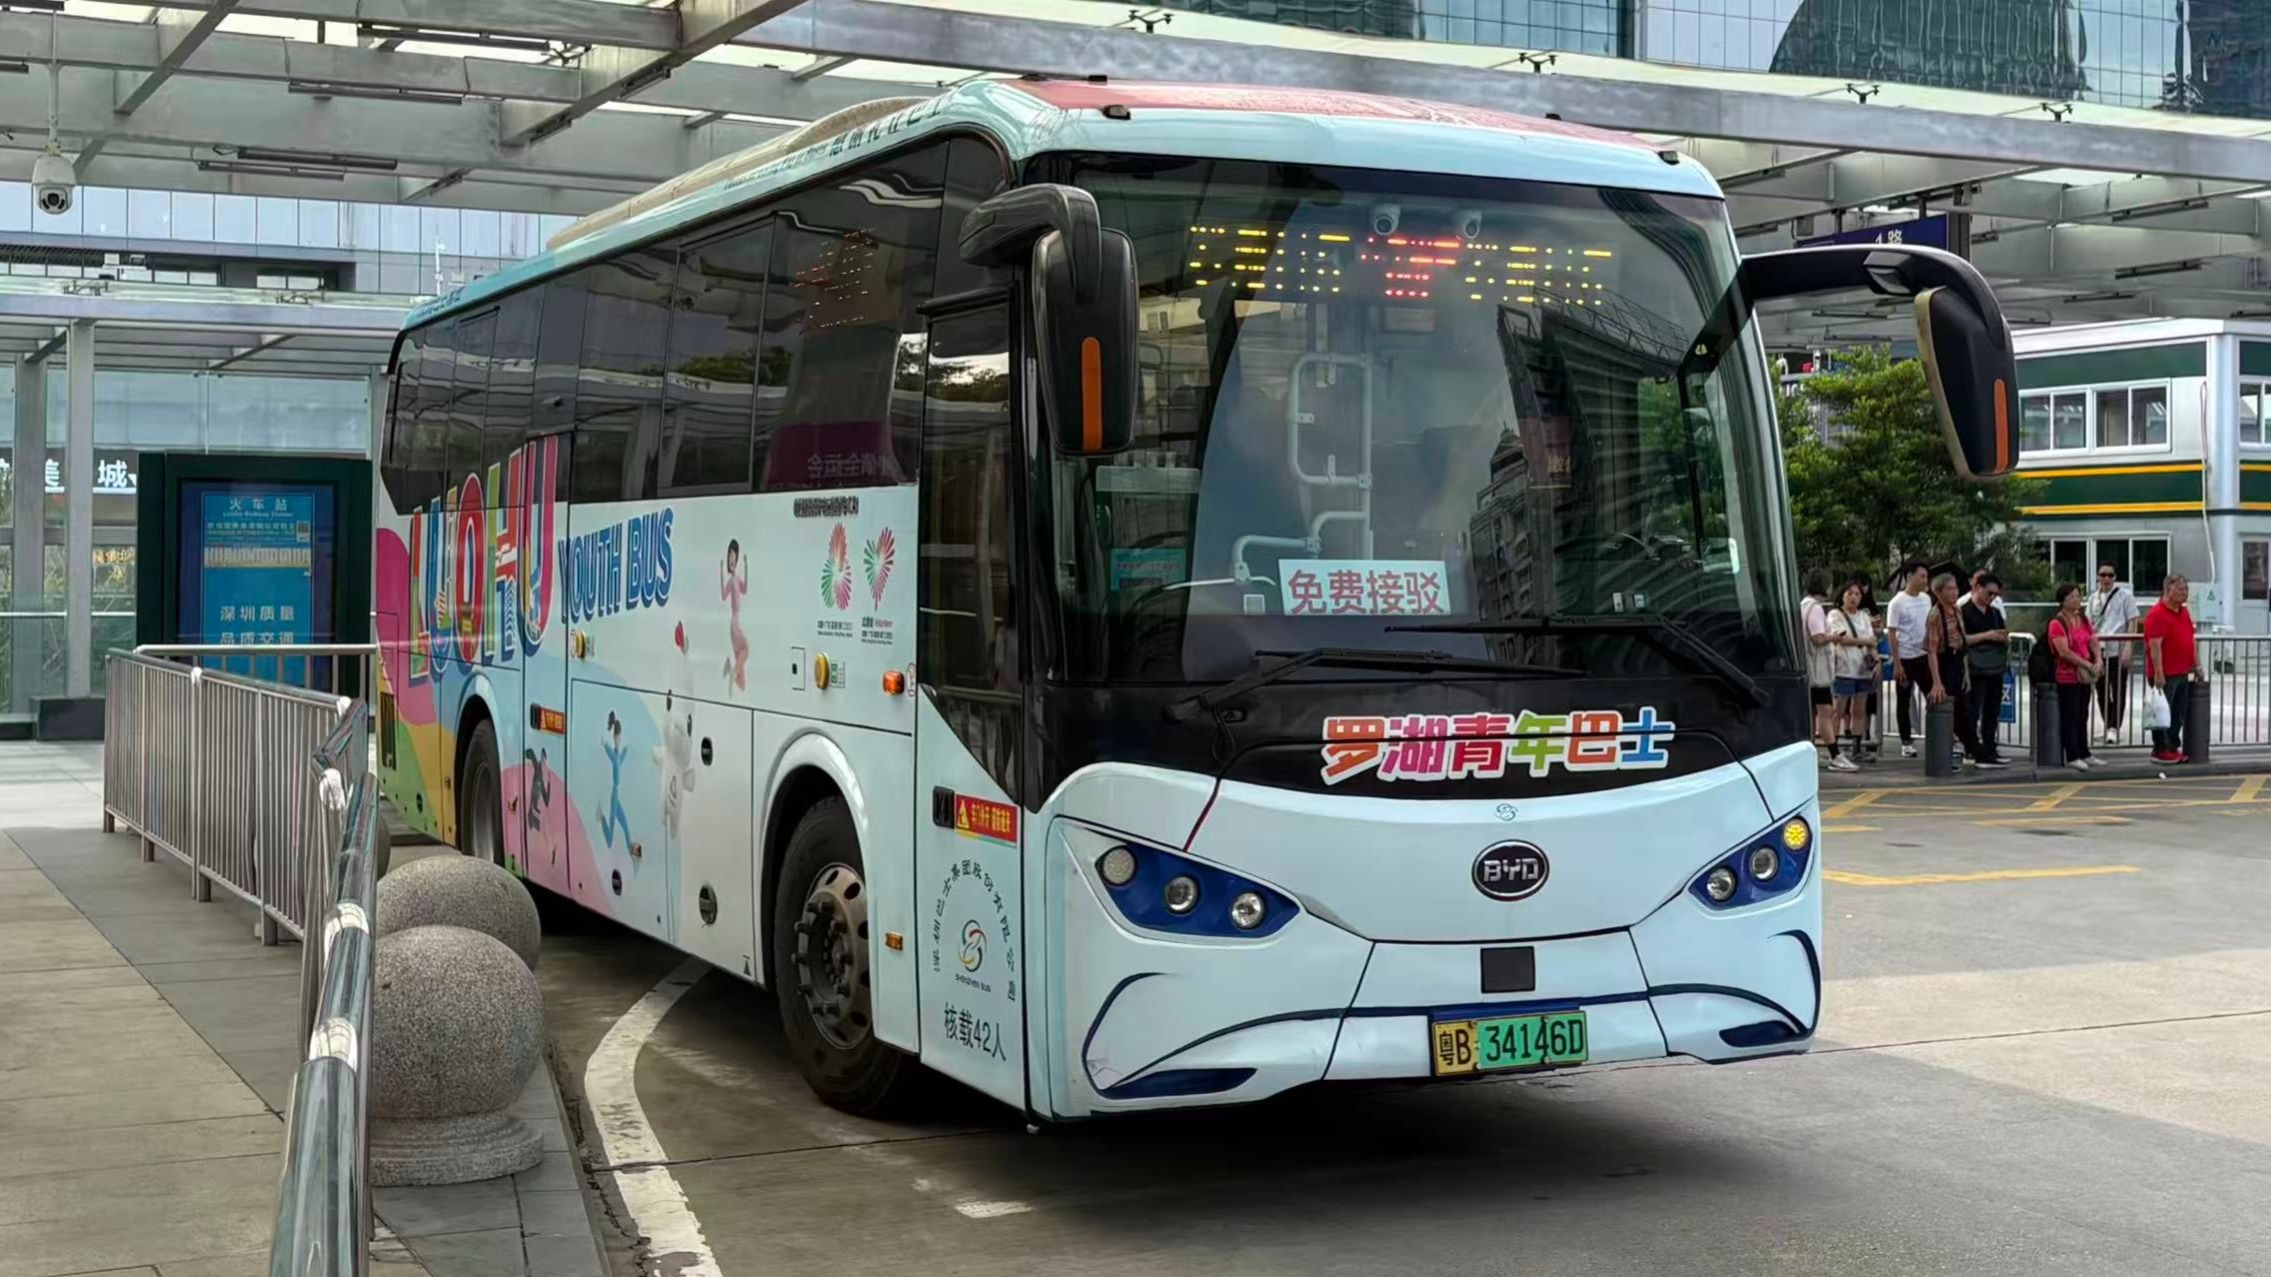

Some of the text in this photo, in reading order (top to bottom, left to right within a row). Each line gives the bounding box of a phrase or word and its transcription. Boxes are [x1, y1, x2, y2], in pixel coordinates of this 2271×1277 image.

[409, 433, 558, 688] LUOHU
[558, 507, 674, 624] YOUTH BUS
[220, 606, 295, 621] 深圳质量
[1288, 570, 1444, 615] 免费接驳
[1322, 707, 1674, 783] 罗湖青年巴士
[1483, 858, 1539, 882] BYD
[944, 1002, 1007, 1062] 核载42人
[1440, 1019, 1585, 1067] 粤B 34146D
